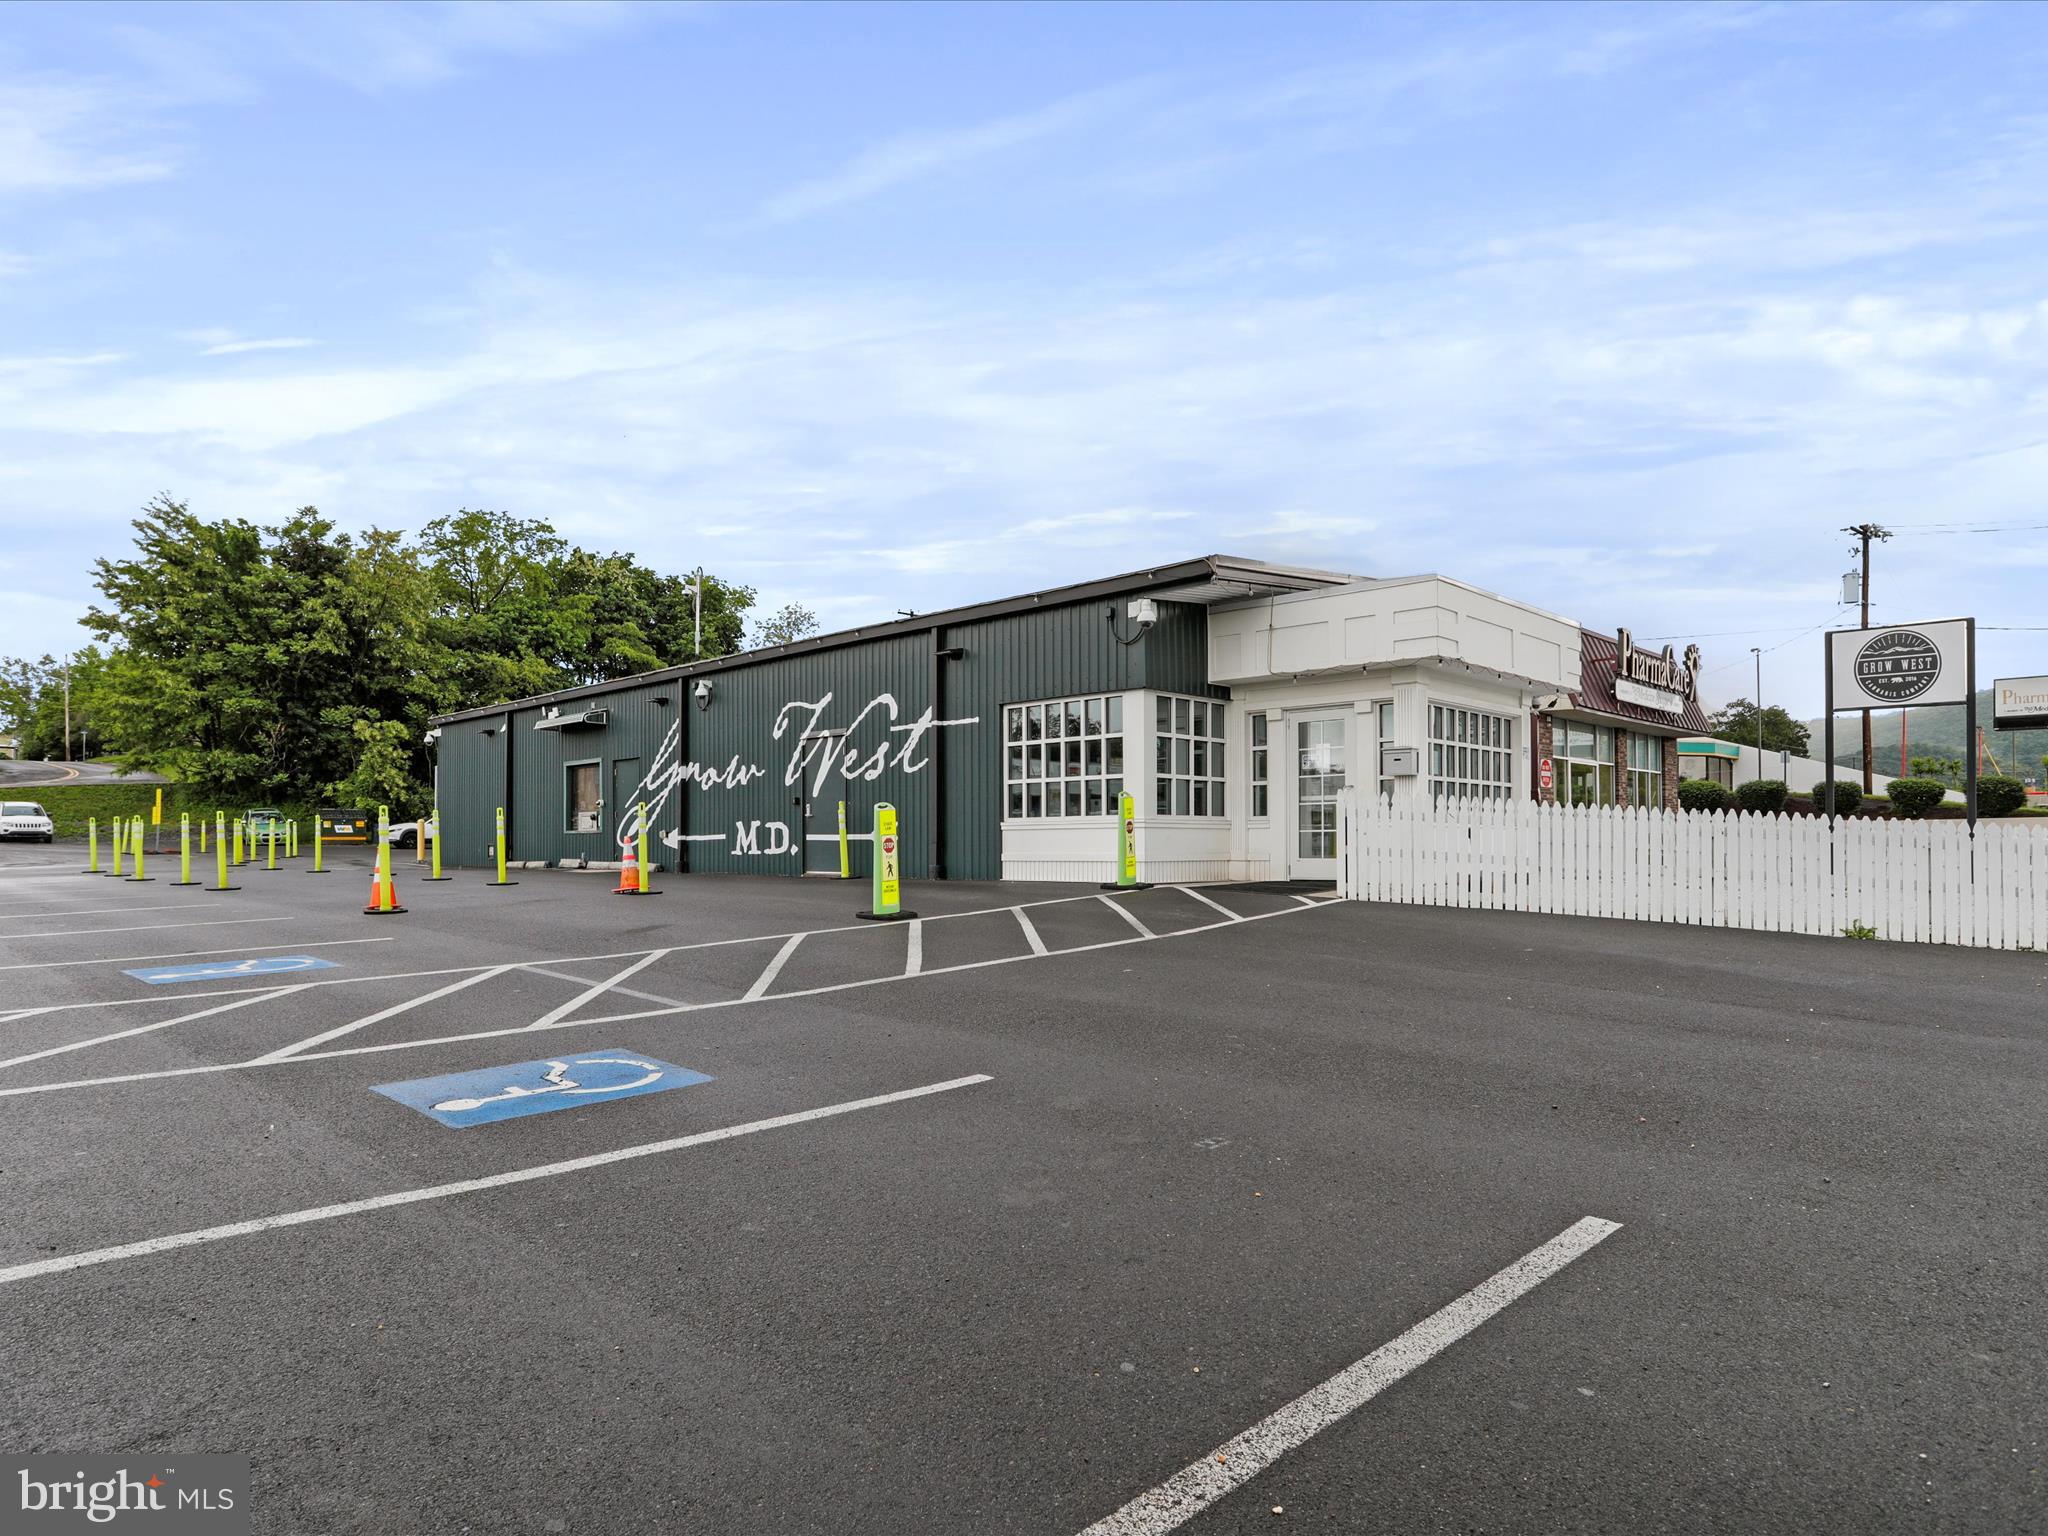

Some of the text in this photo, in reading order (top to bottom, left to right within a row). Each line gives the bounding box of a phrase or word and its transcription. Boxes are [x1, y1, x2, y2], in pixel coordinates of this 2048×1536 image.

[1617, 627, 1690, 694] PharmaCare
[1863, 657, 1933, 674] GROW WEST
[1865, 676, 1930, 697] CANNABIS COMPANY
[616, 691, 980, 848] Grow West
[731, 820, 800, 856] MD.
[883, 842, 895, 850] STOP
